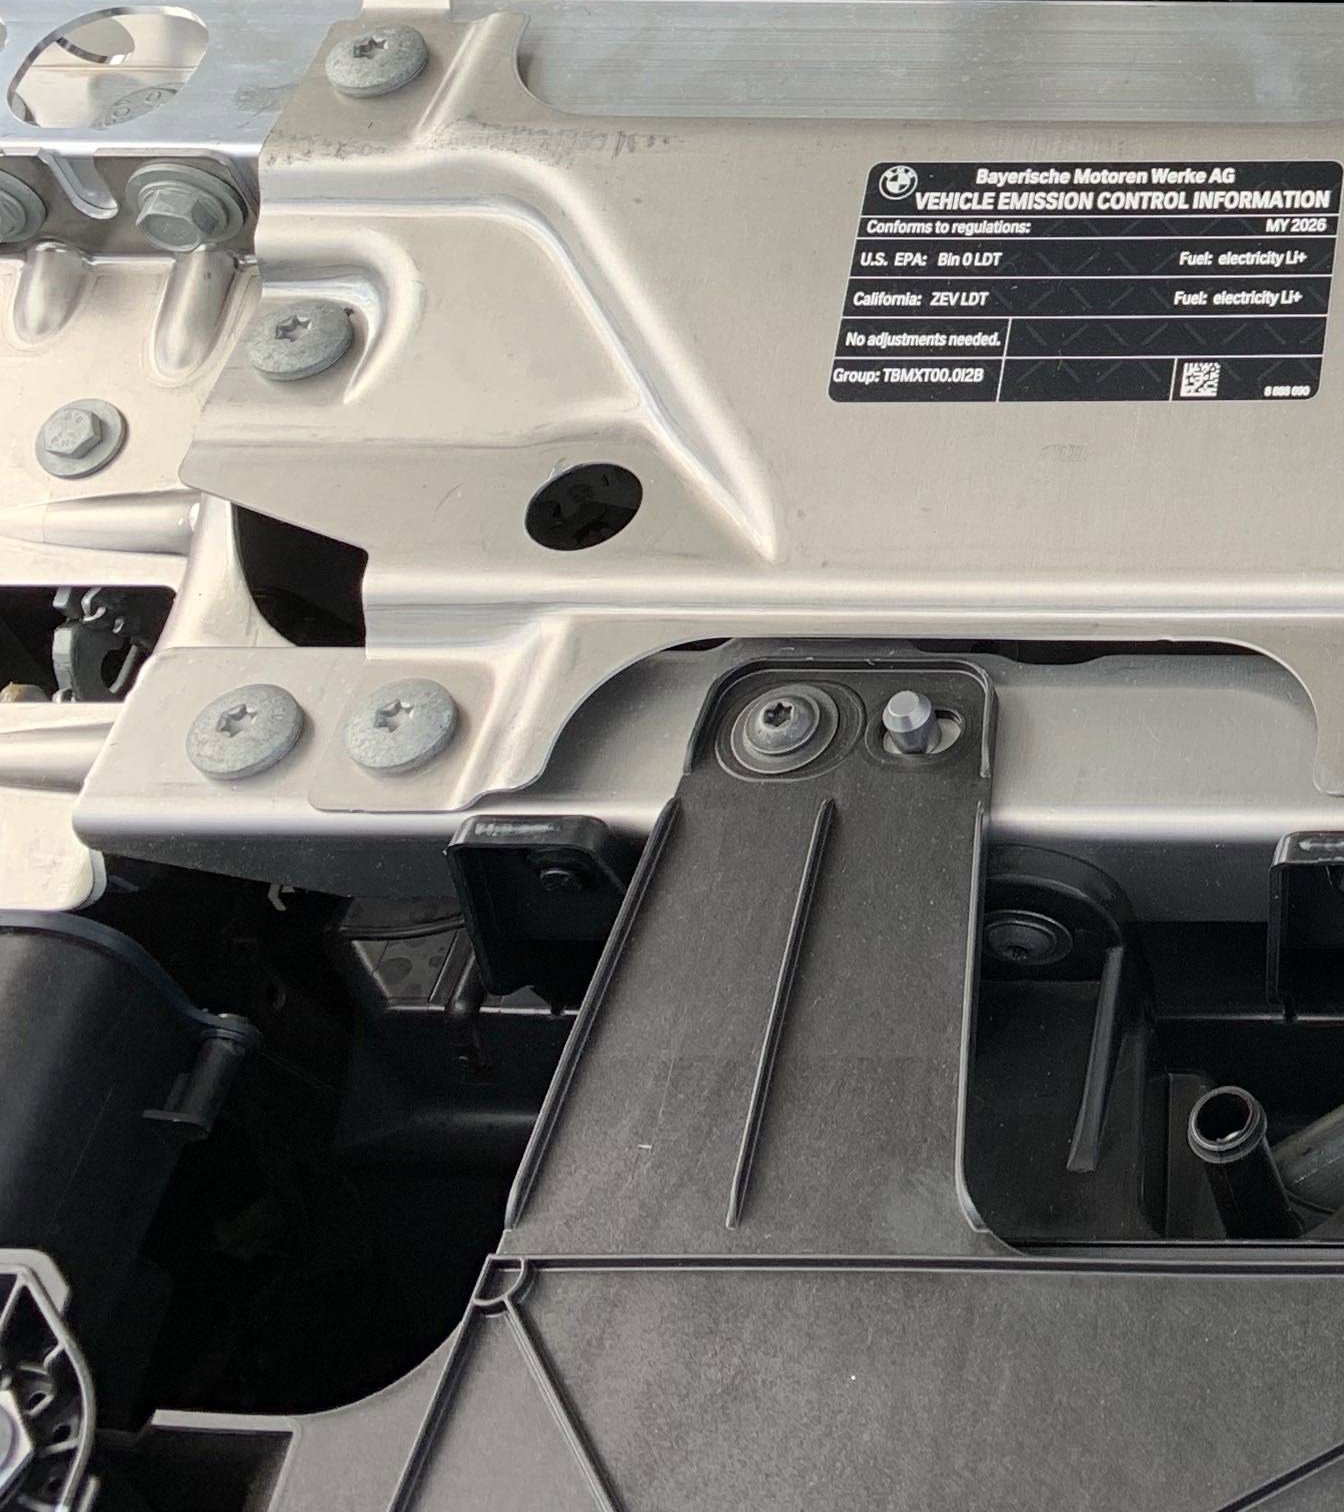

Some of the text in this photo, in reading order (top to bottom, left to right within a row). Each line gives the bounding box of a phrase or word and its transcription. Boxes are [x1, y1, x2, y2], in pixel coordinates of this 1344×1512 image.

[976, 168, 1236, 186] Bayerische Motoren Werke AG
[916, 191, 1331, 210] VEHICLE EMISSION CONTROL INFORMATION
[866, 220, 1031, 237] Conforms to regulations:
[1265, 219, 1327, 232] MY 2026
[860, 253, 928, 267] U.S. EPA:
[937, 252, 1002, 267] Bin 0 LDT
[1179, 251, 1308, 268] Fuel: electricity Li+
[853, 291, 989, 306] California: ZEV LDT
[1174, 291, 1303, 308] Fuel: electricity Li+
[845, 332, 1001, 349] No adjustments needed.
[832, 369, 880, 386] Group:
